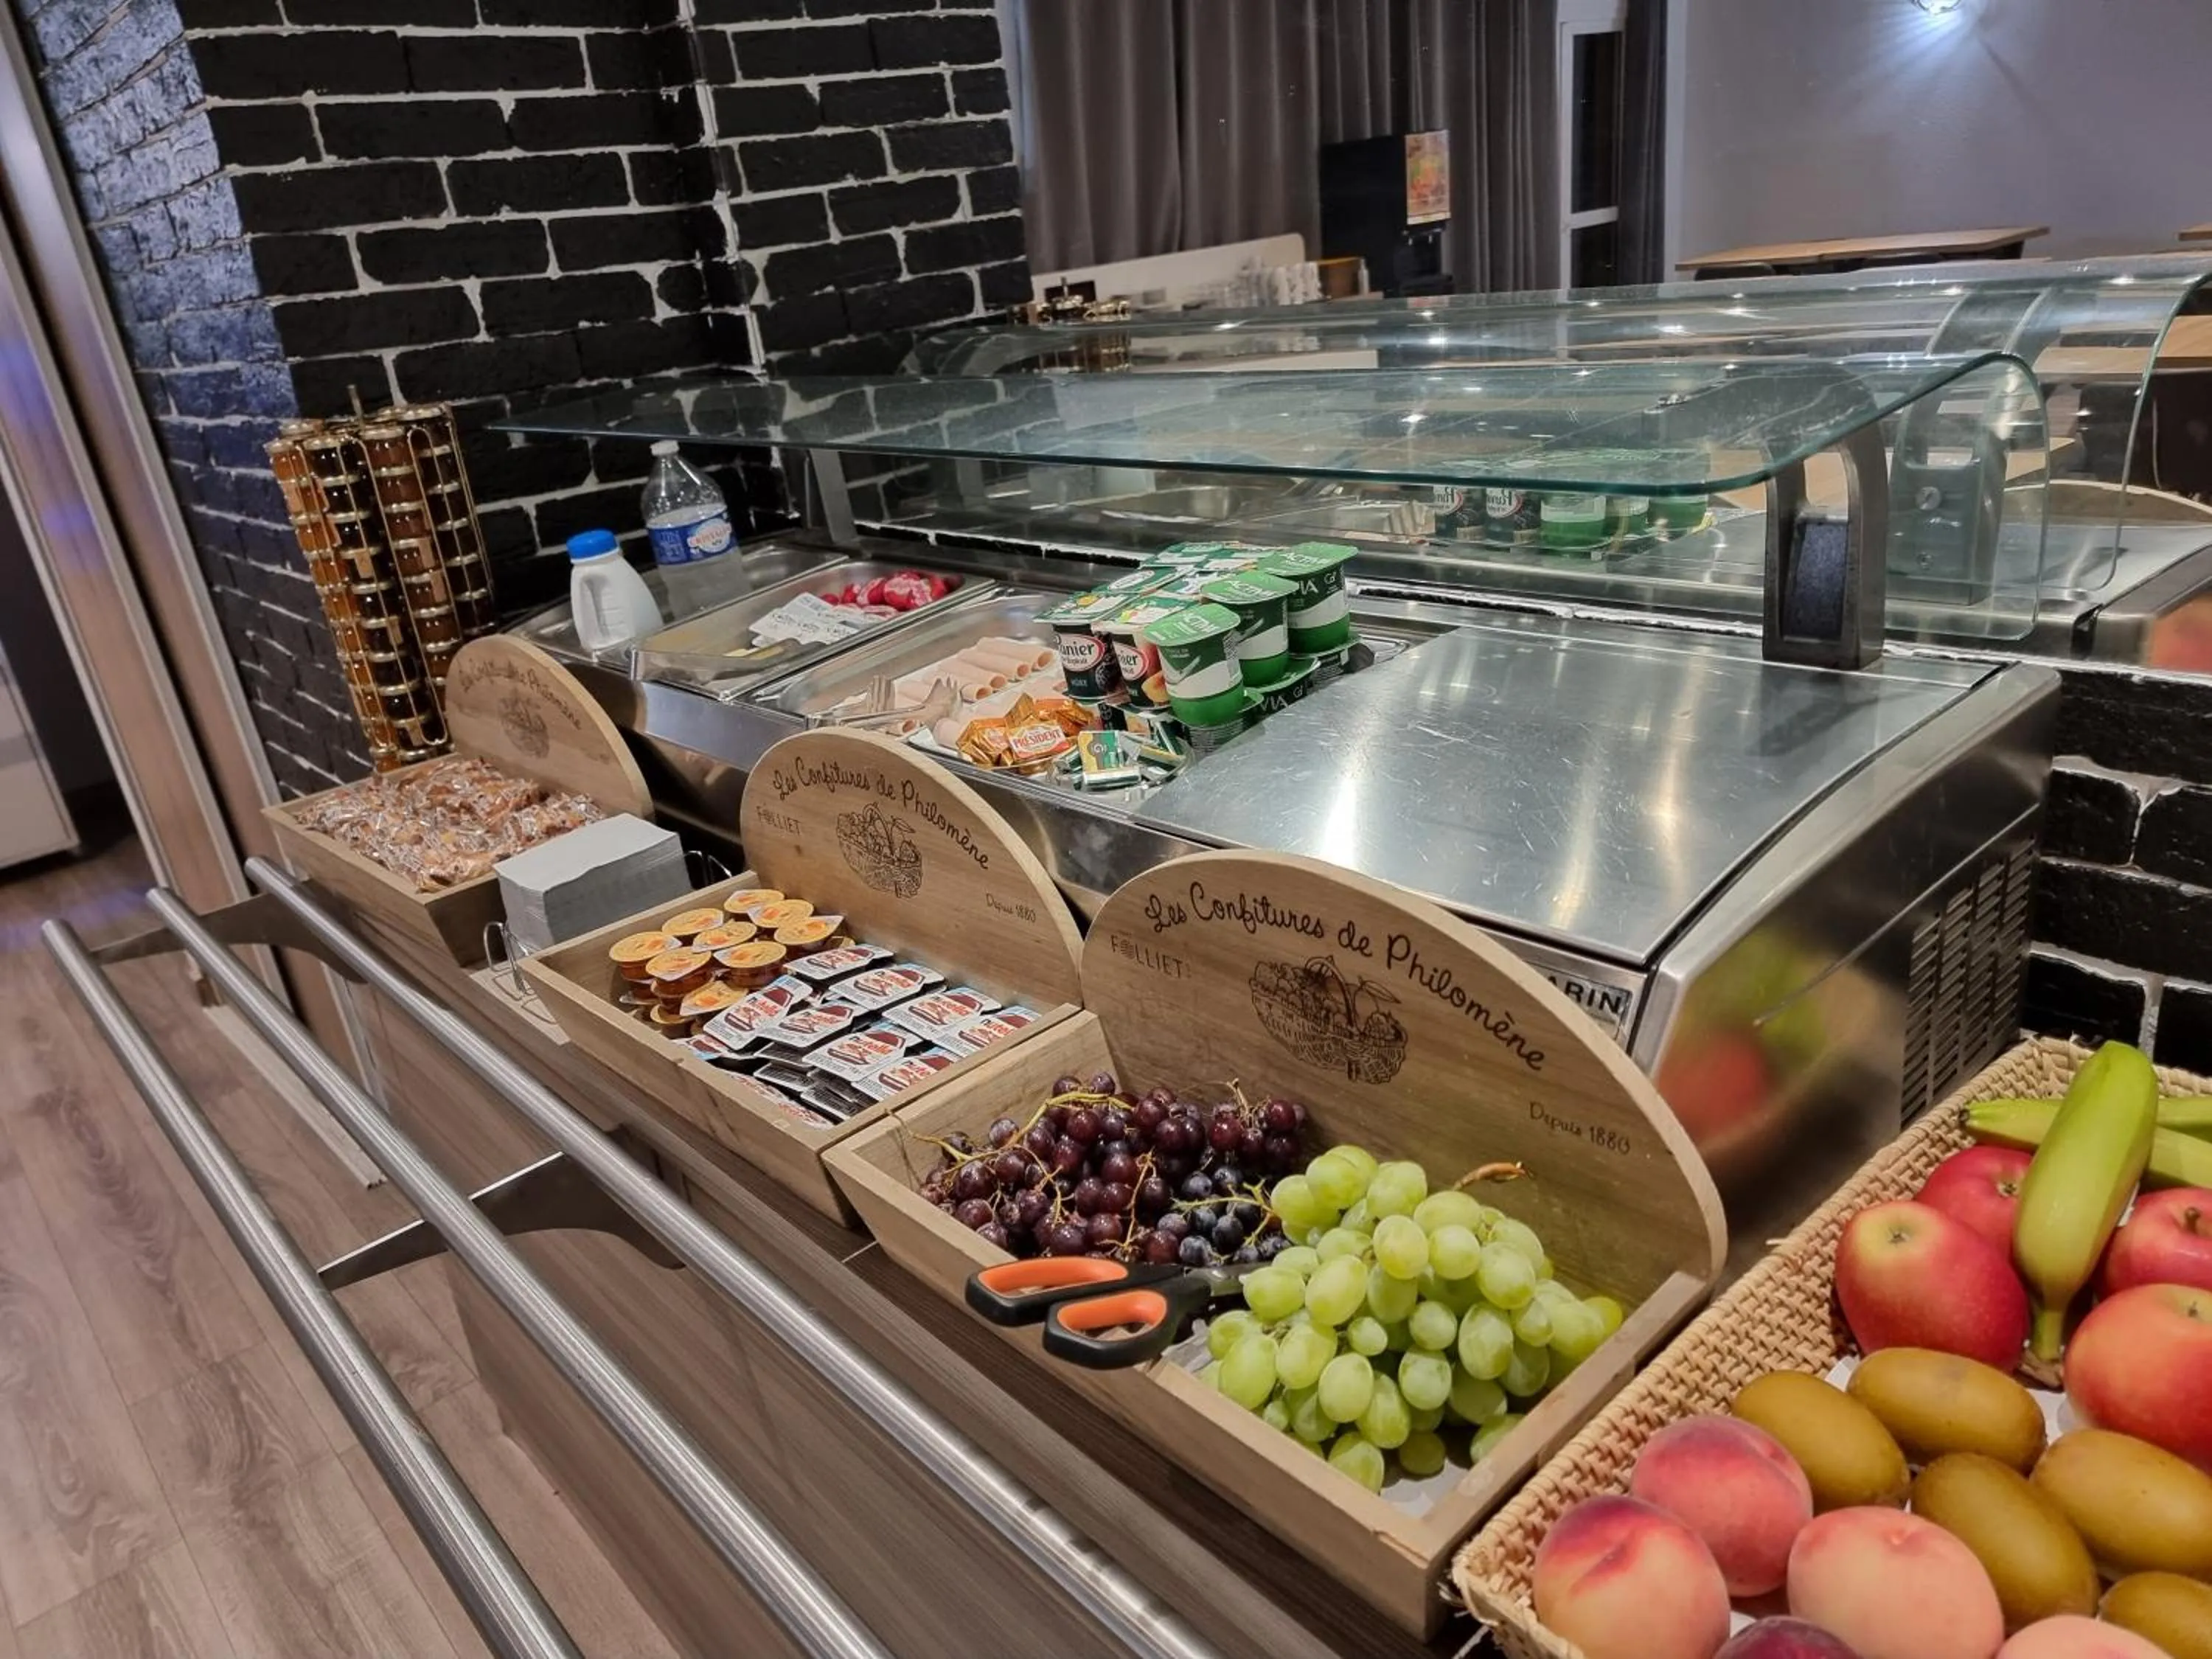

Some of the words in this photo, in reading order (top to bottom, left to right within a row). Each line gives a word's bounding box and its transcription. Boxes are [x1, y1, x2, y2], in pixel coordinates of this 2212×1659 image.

[773, 770, 798, 801] Les
[795, 756, 871, 793] Confitures
[876, 774, 897, 800] de
[901, 779, 990, 870] Philomène
[1144, 894, 1188, 933] Les
[1189, 881, 1325, 939] Confitures
[1338, 919, 1373, 957] de
[1386, 933, 1545, 1071] Philomène
[1528, 1101, 1583, 1138] Depuis
[1587, 1125, 1631, 1155] 1880
